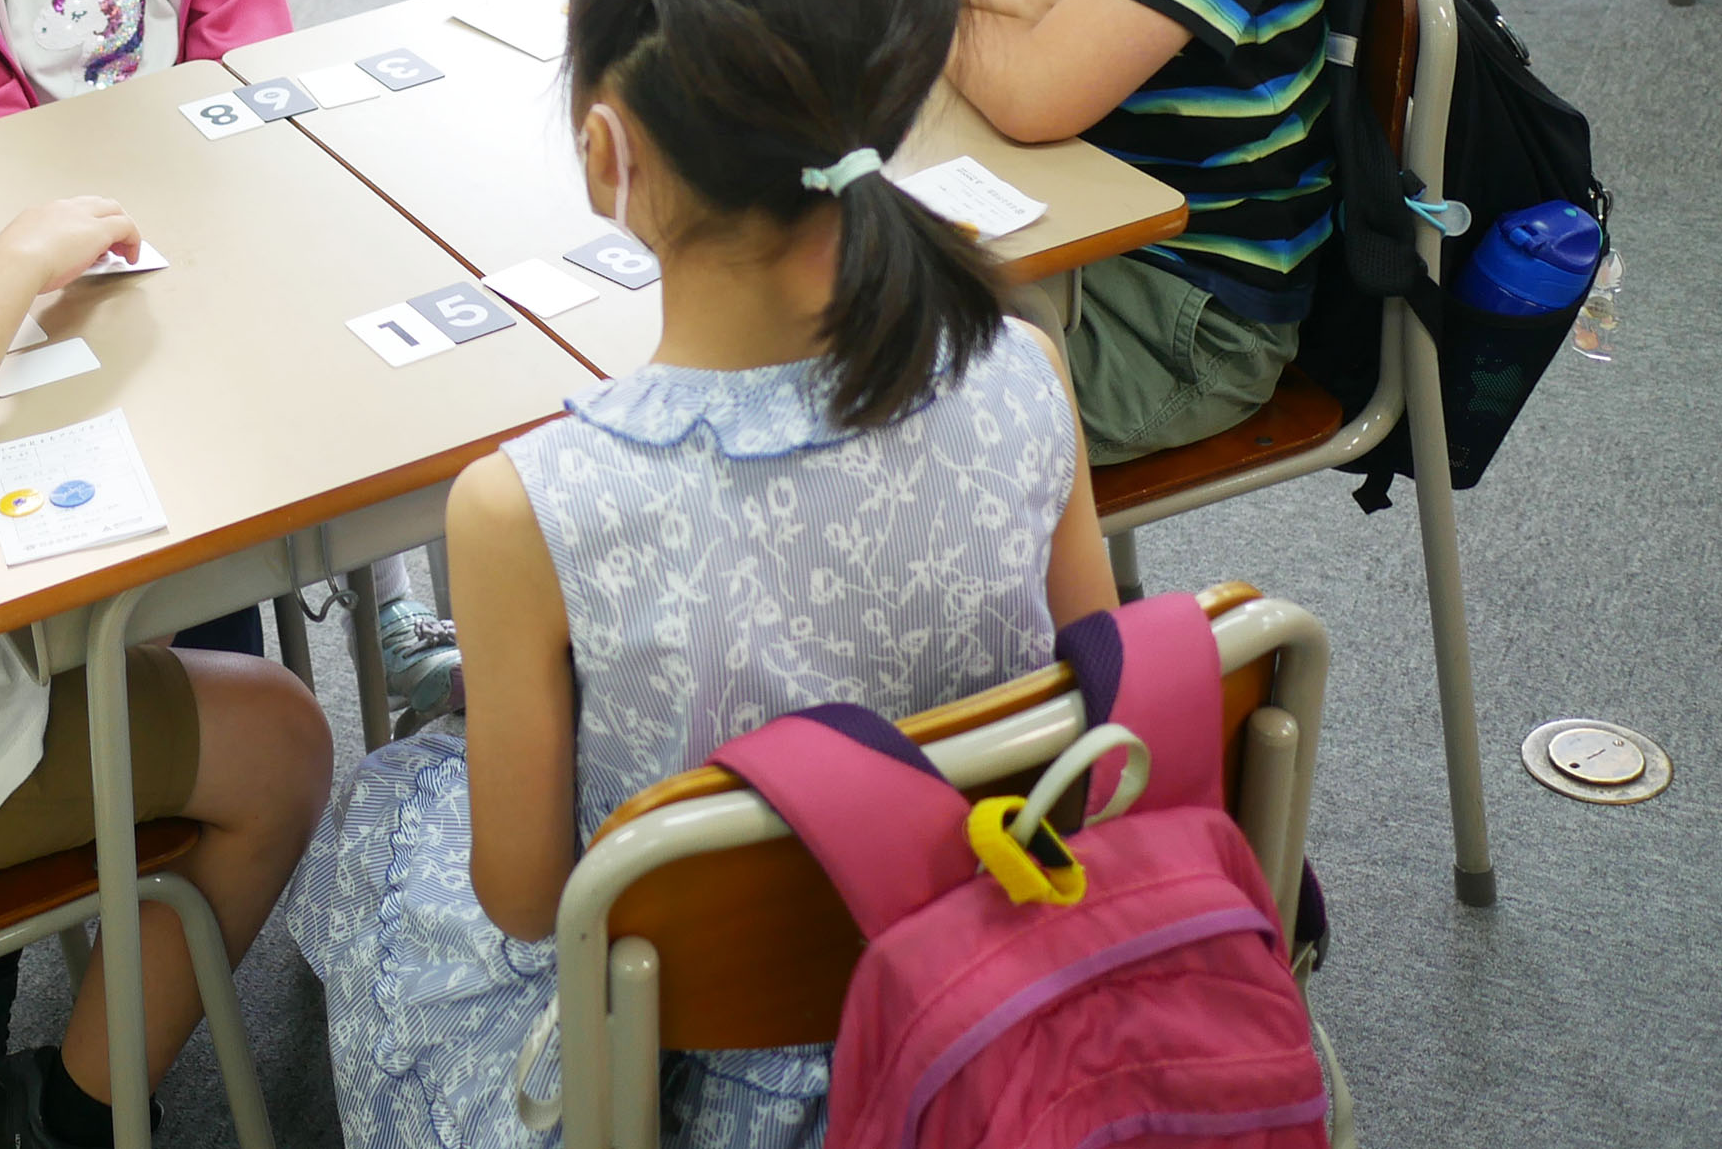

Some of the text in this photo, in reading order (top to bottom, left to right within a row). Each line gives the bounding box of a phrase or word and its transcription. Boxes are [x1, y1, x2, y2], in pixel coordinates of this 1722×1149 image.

[376, 57, 421, 80] 3
[200, 104, 239, 126] 8
[377, 247, 653, 347] 1 5 8
